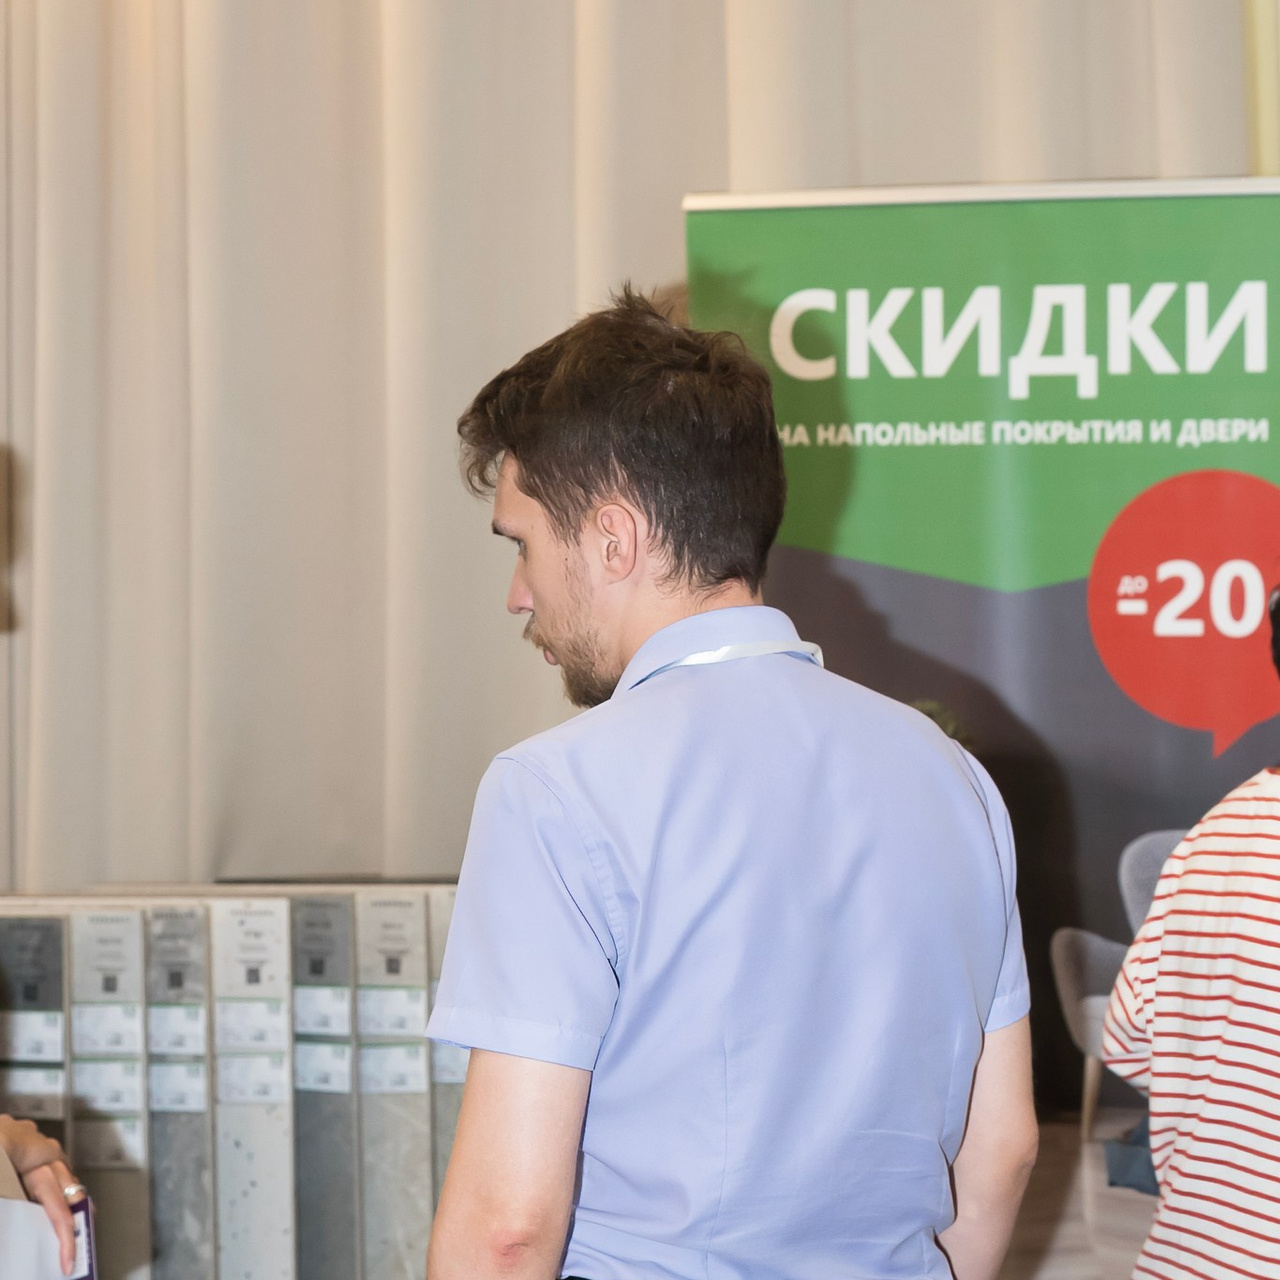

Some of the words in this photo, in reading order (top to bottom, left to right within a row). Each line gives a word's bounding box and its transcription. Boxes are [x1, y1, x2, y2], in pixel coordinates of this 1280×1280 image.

[769, 280, 1268, 401] СКИДКИ
[816, 421, 985, 447] НАПОЛЬНЫЕ
[991, 420, 1143, 446] ПОКРЫТИЯ
[1149, 420, 1172, 445] И
[1176, 418, 1269, 448] ДВЕРИ
